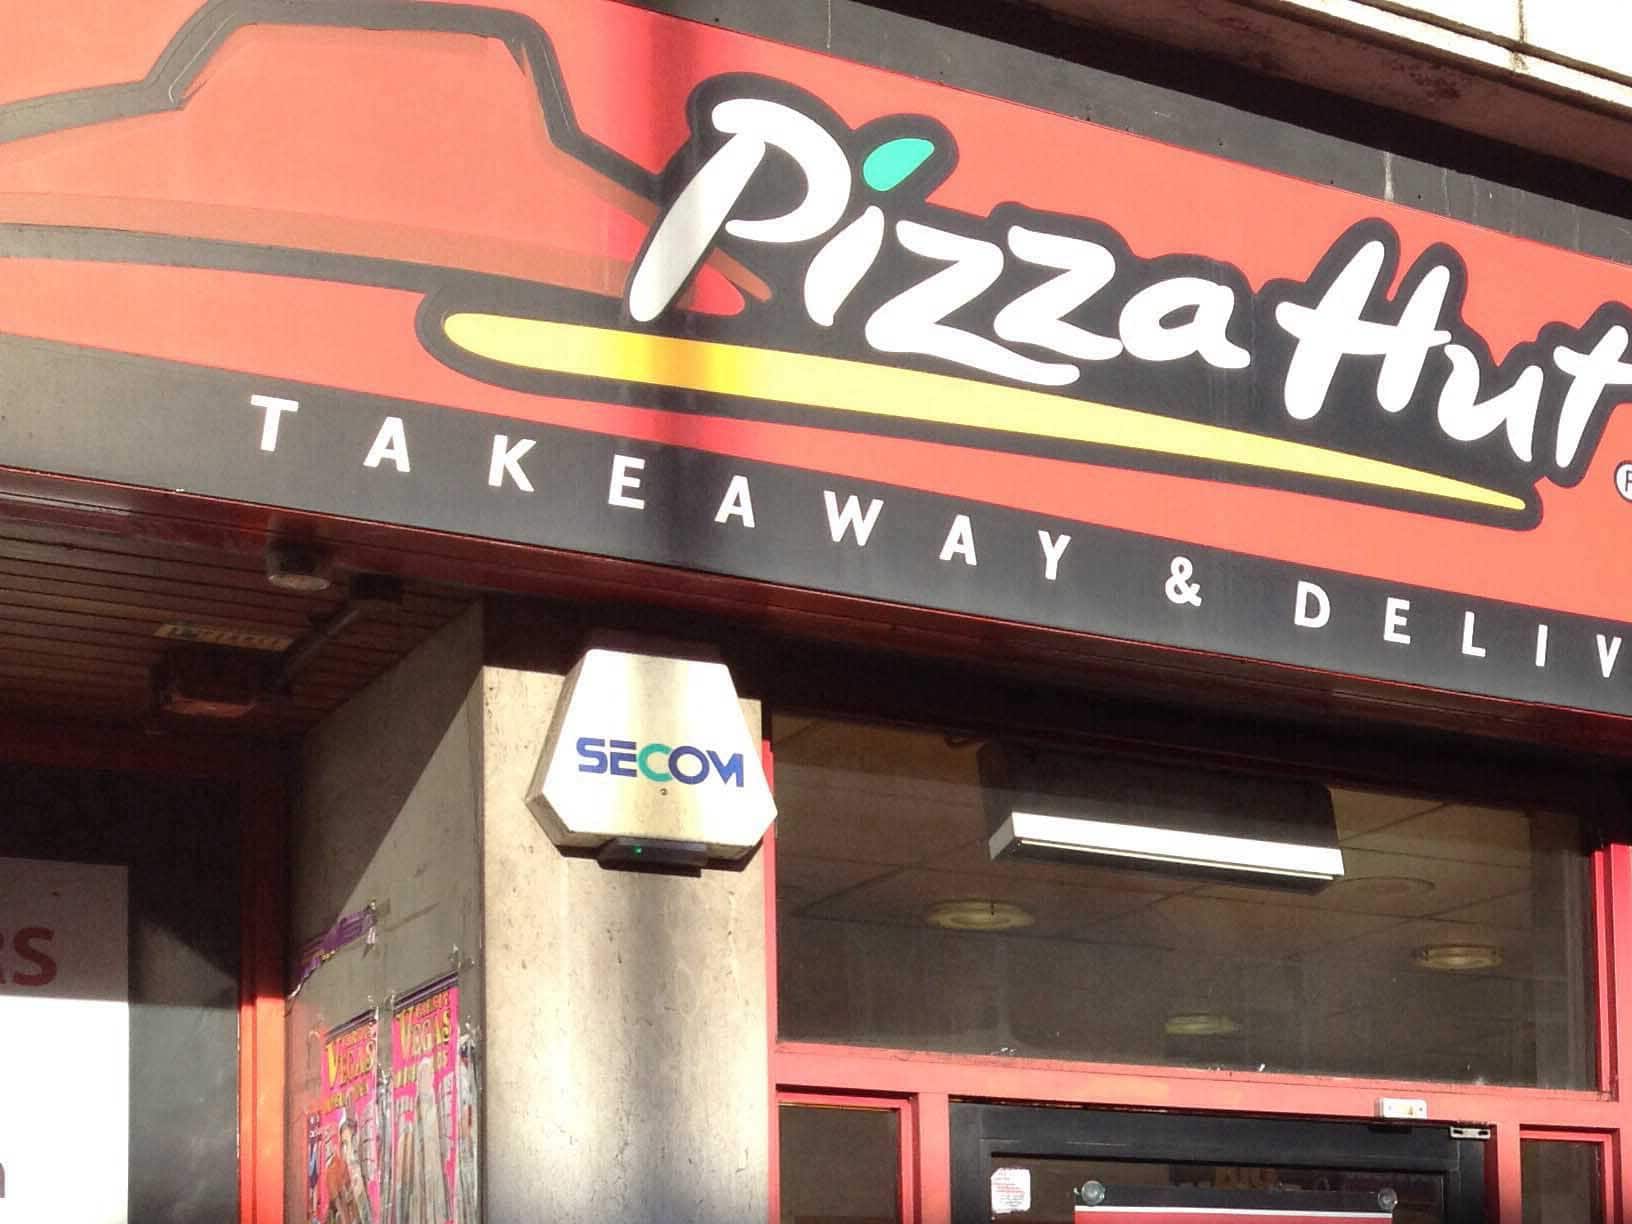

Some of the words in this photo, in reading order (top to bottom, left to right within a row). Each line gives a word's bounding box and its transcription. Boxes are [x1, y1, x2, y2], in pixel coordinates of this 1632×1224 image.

[628, 97, 1250, 386] Pizza
[250, 394, 1072, 581] TAKEAWAY
[1165, 556, 1203, 607] &
[576, 737, 744, 788] SECOM
